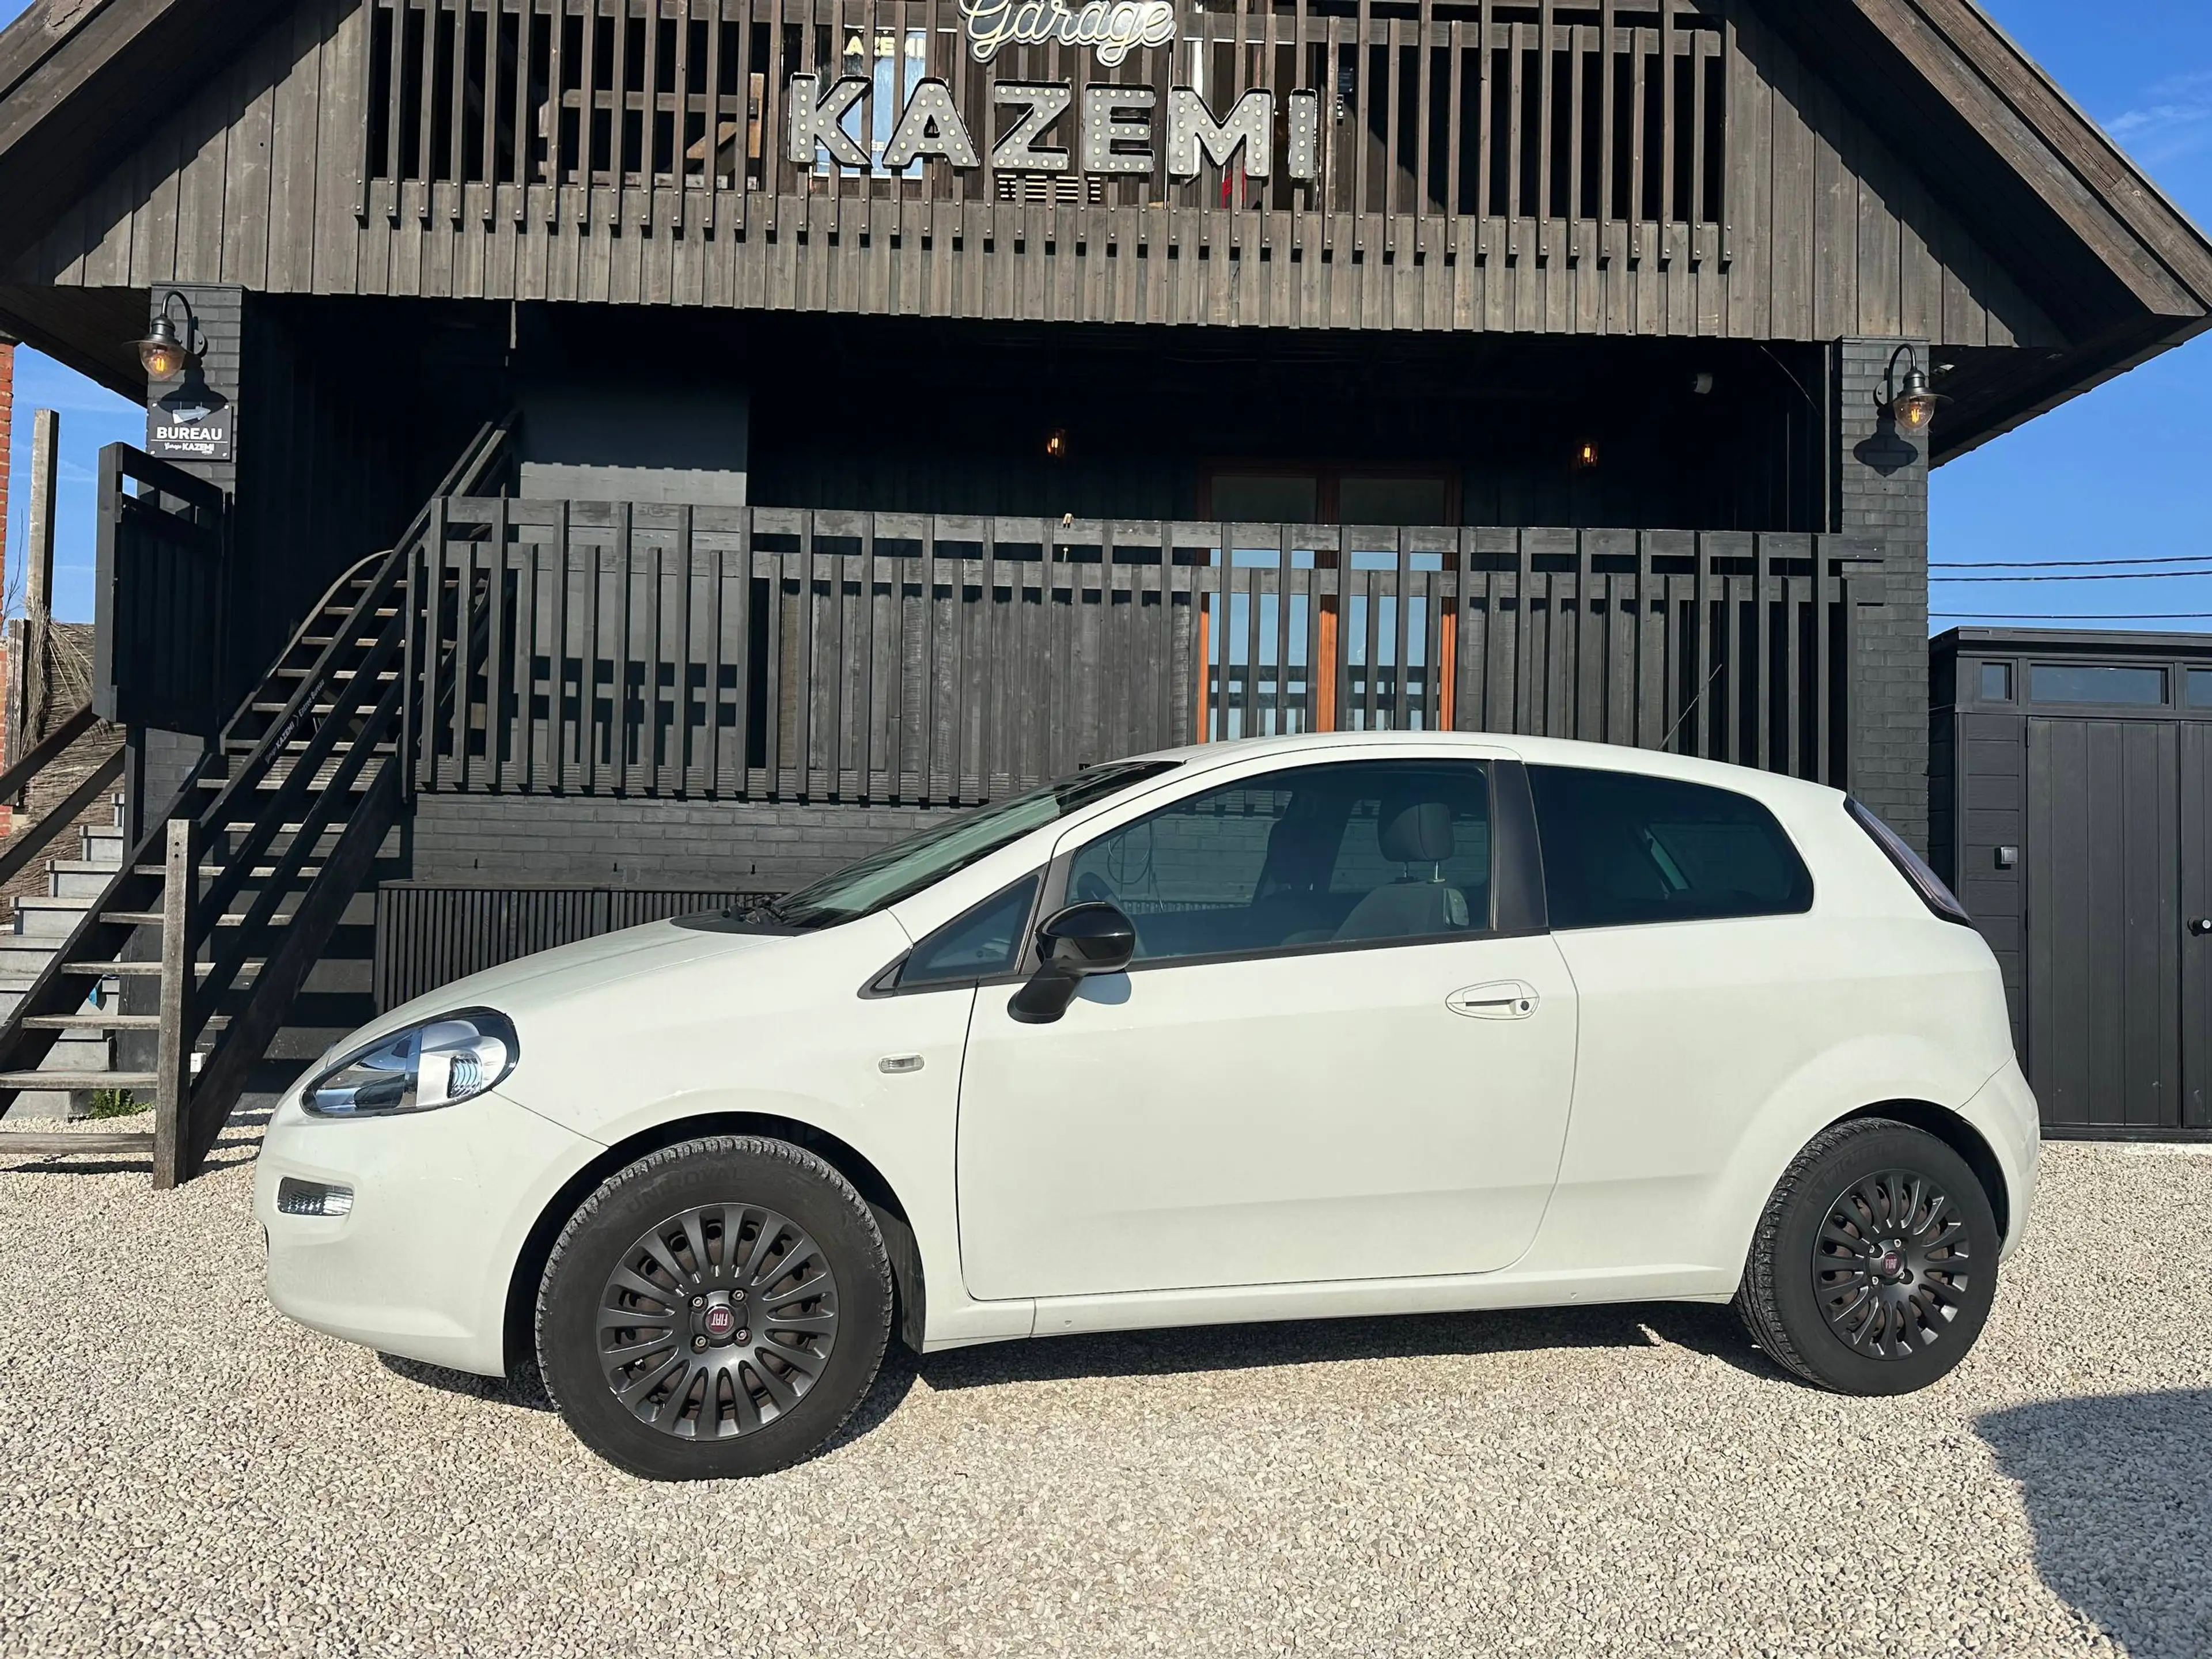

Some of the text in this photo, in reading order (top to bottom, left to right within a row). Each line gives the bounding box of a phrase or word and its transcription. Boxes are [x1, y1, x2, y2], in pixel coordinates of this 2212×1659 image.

[961, 0, 1177, 67] Garage
[789, 73, 1318, 180] KAZEMI
[157, 427, 222, 440] BUREAU
[182, 442, 214, 451] KAZEMI
[275, 721, 294, 749] KAZEMI
[1886, 1259, 1897, 1269] FIAT
[711, 1313, 728, 1326] FIAT
